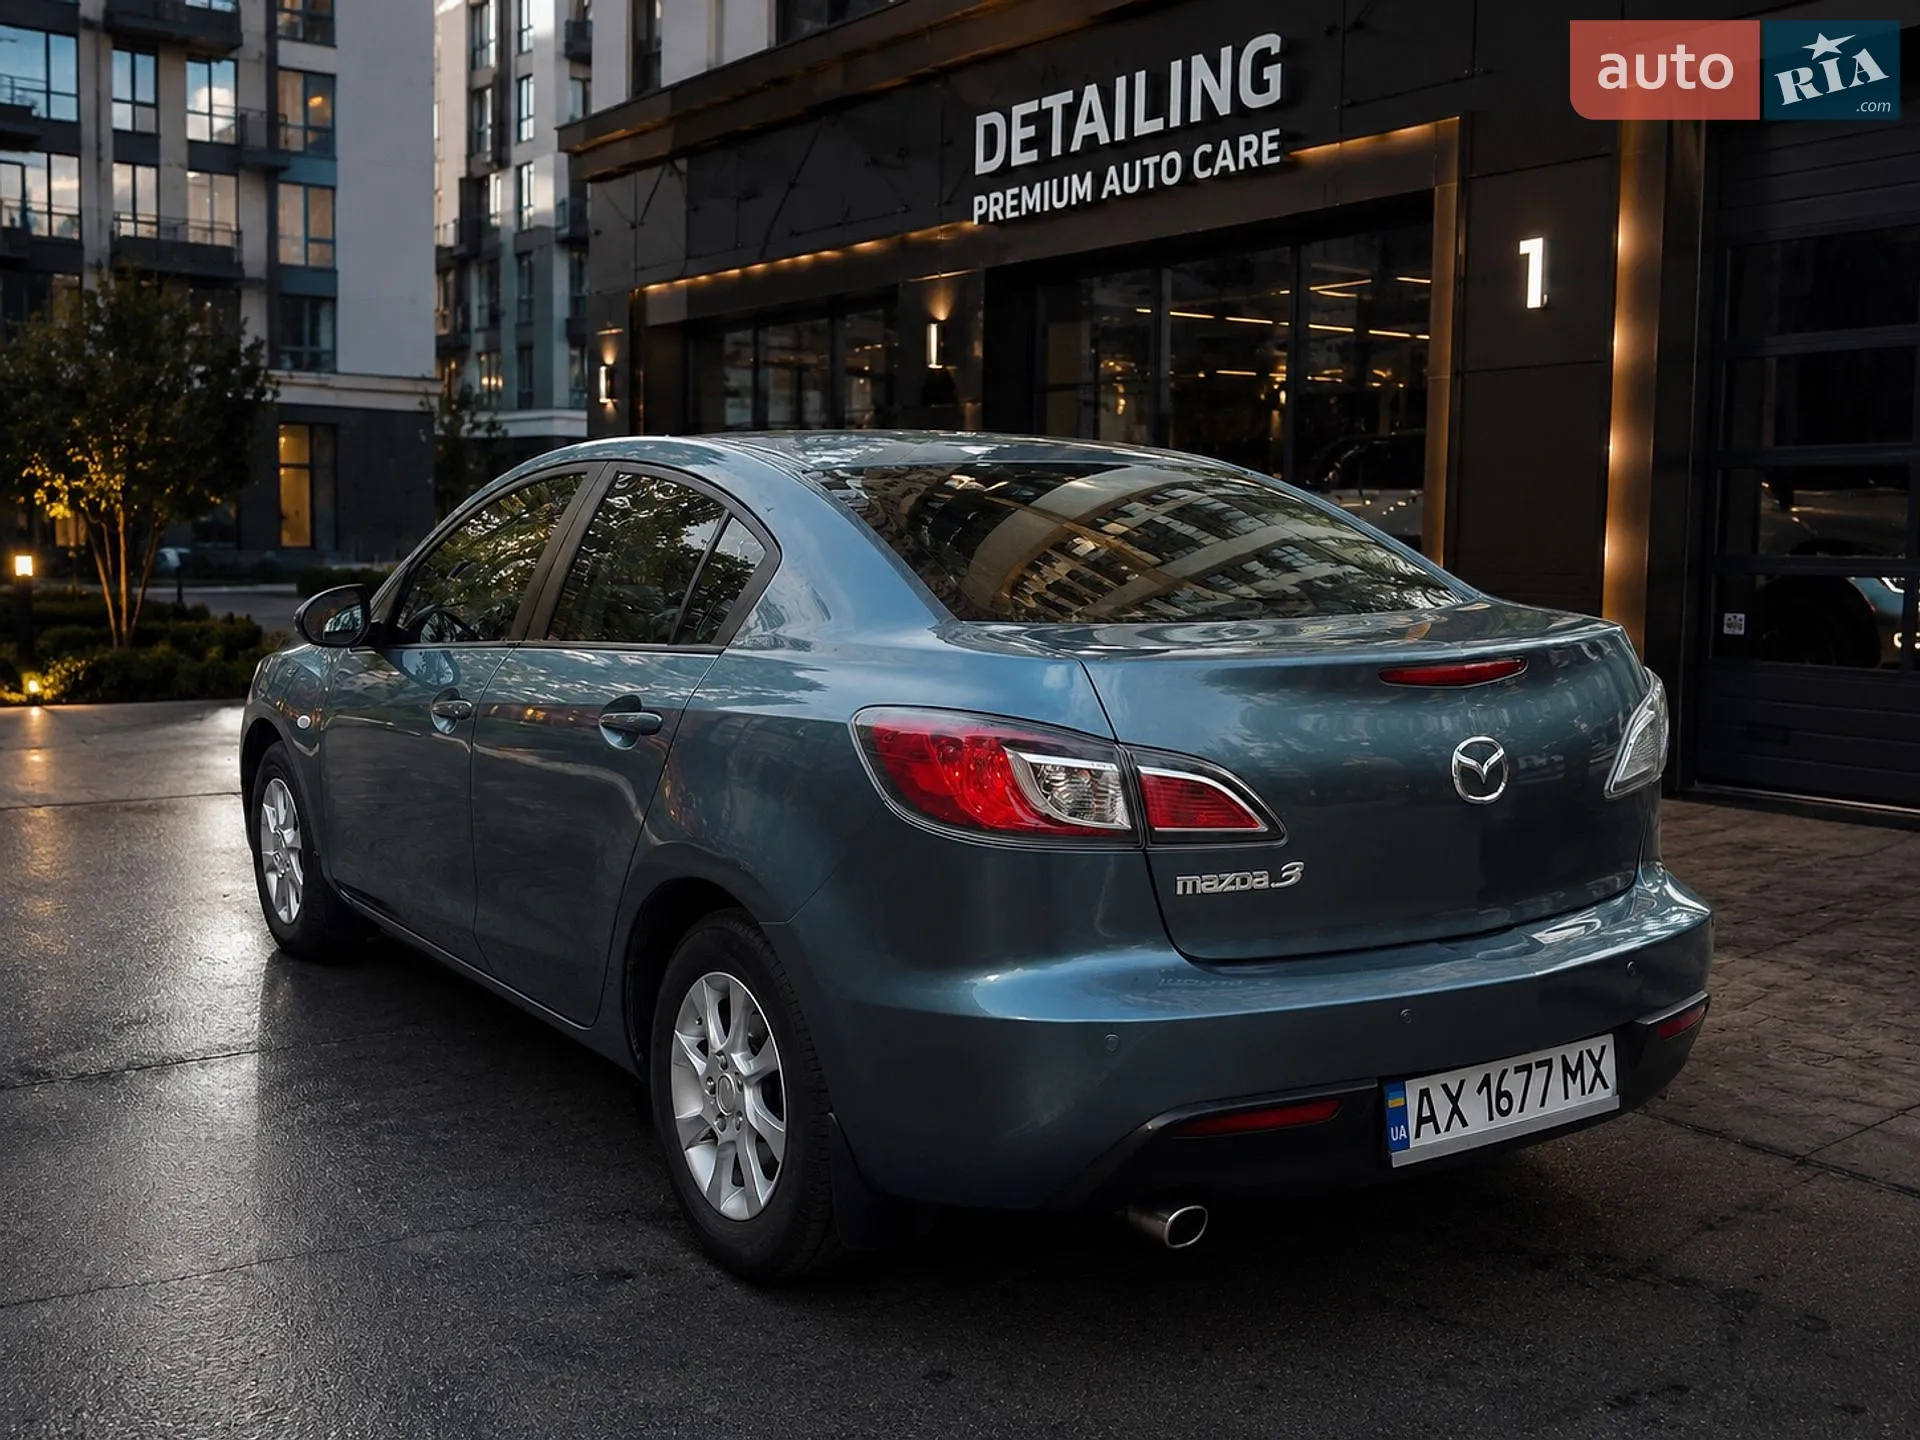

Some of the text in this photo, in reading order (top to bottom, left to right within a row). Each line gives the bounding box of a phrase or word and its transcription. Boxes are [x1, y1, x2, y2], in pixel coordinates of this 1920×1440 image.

[975, 33, 1282, 176] DETAILING
[973, 128, 1281, 225] PREMIUM AUTO CARE
[1519, 237, 1540, 308] 1
[1391, 1125, 1408, 1141] UA
[1414, 1045, 1609, 1139] AX 1677 MX
